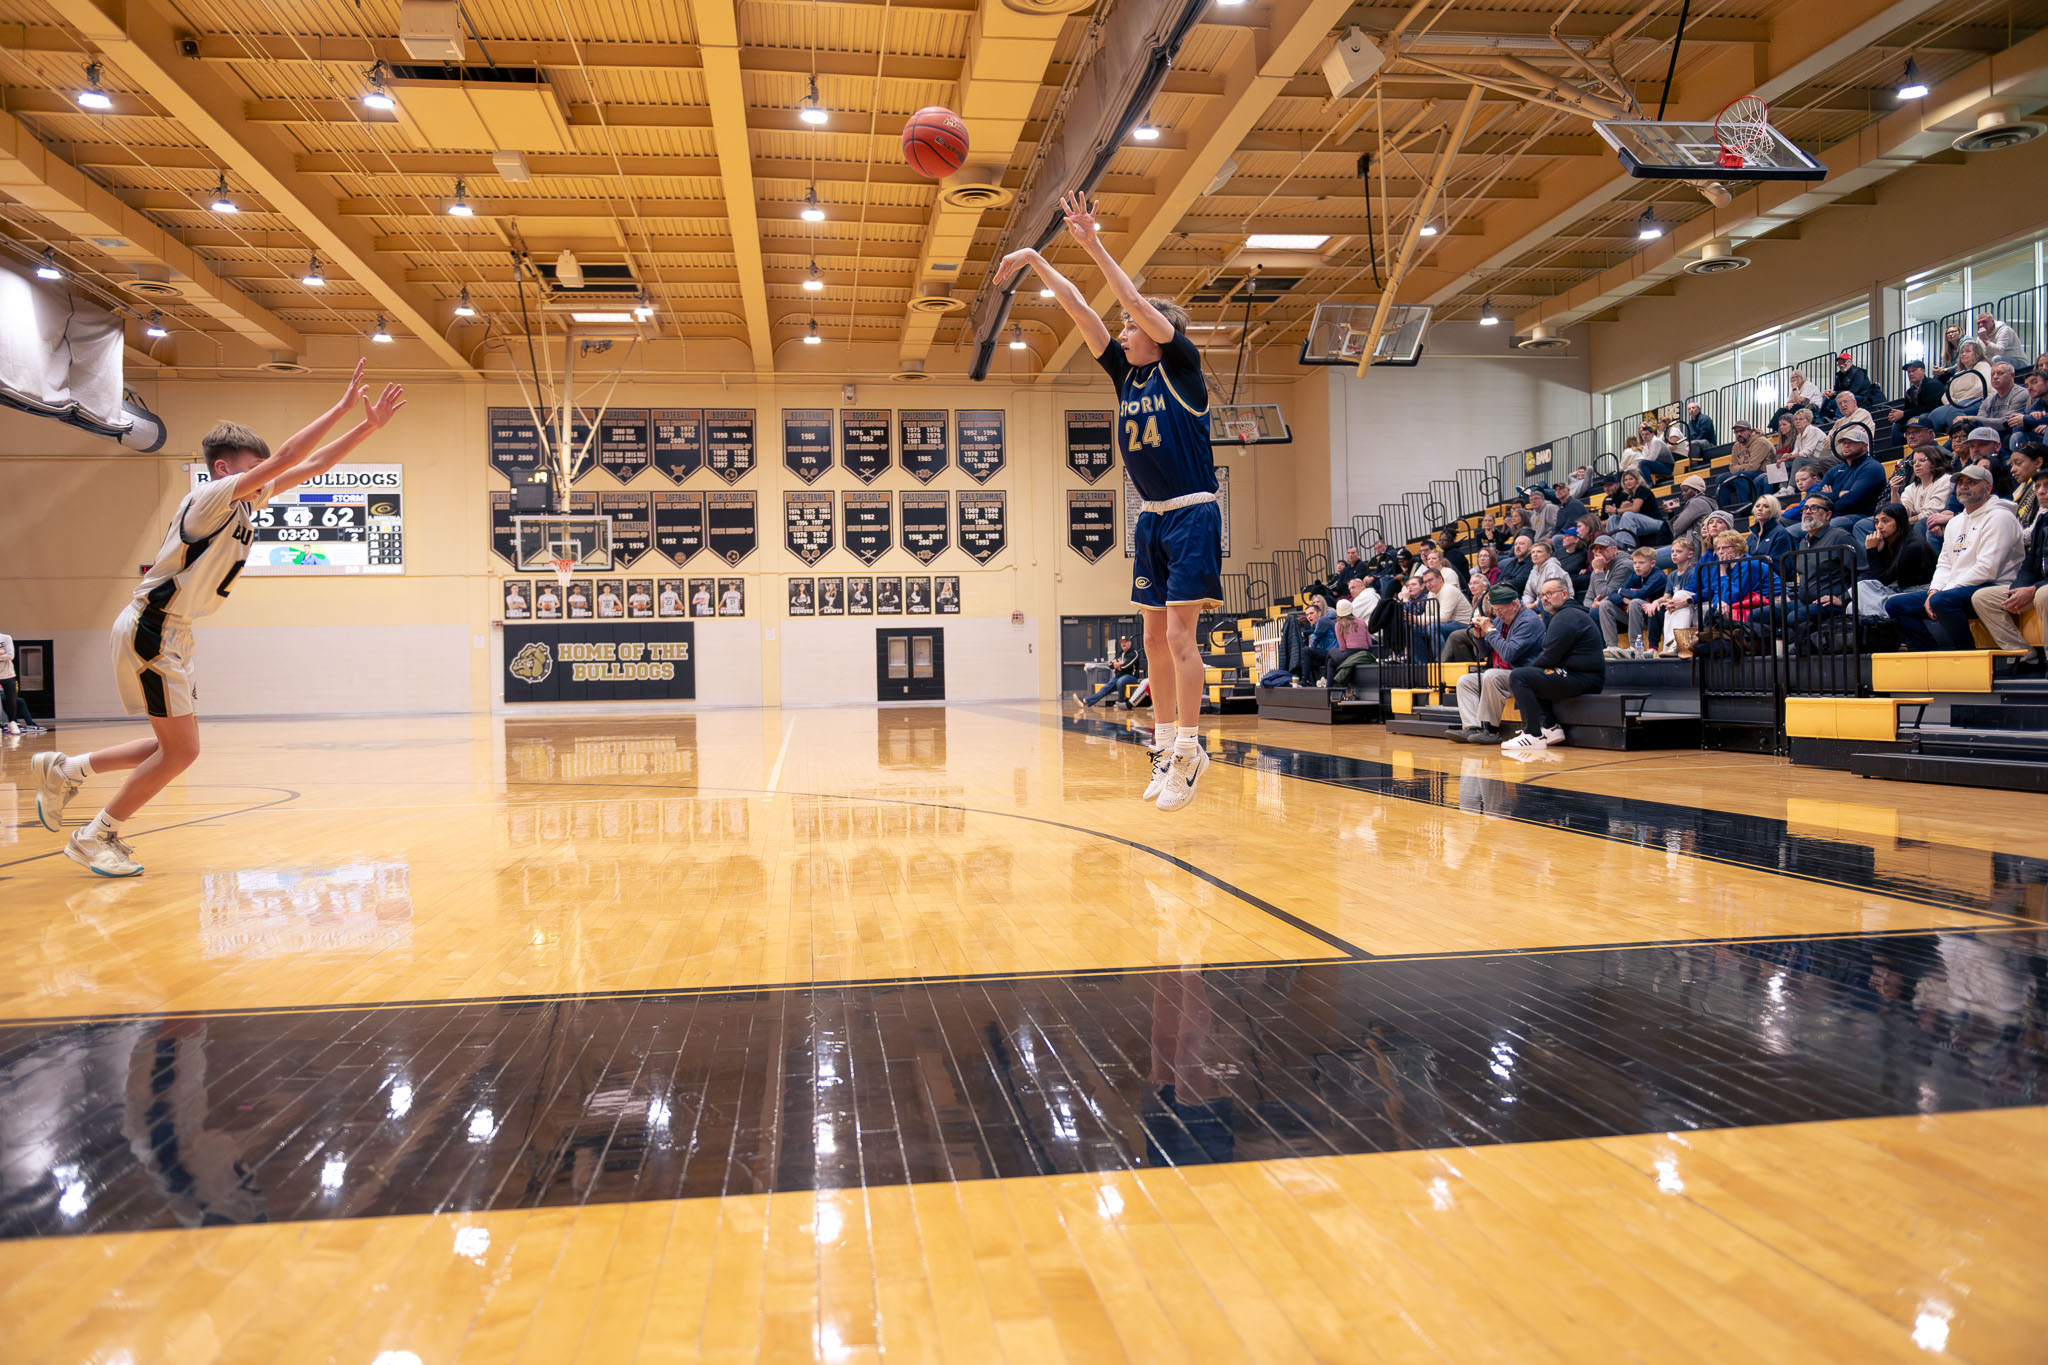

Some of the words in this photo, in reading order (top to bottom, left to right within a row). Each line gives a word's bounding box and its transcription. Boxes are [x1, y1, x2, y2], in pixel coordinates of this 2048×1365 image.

[1120, 394, 1166, 417] STORM
[1125, 415, 1161, 451] 24
[332, 494, 364, 502] STORM
[712, 493, 728, 501] GIRLS
[730, 493, 749, 501] SOCCER
[294, 513, 302, 523] 4
[322, 508, 354, 527] 62
[278, 529, 319, 541] 03:20
[351, 533, 359, 542] 2
[558, 643, 616, 661] HOME
[618, 643, 645, 660] OF
[648, 642, 688, 660] THE
[573, 662, 674, 680] BULLDOGS
